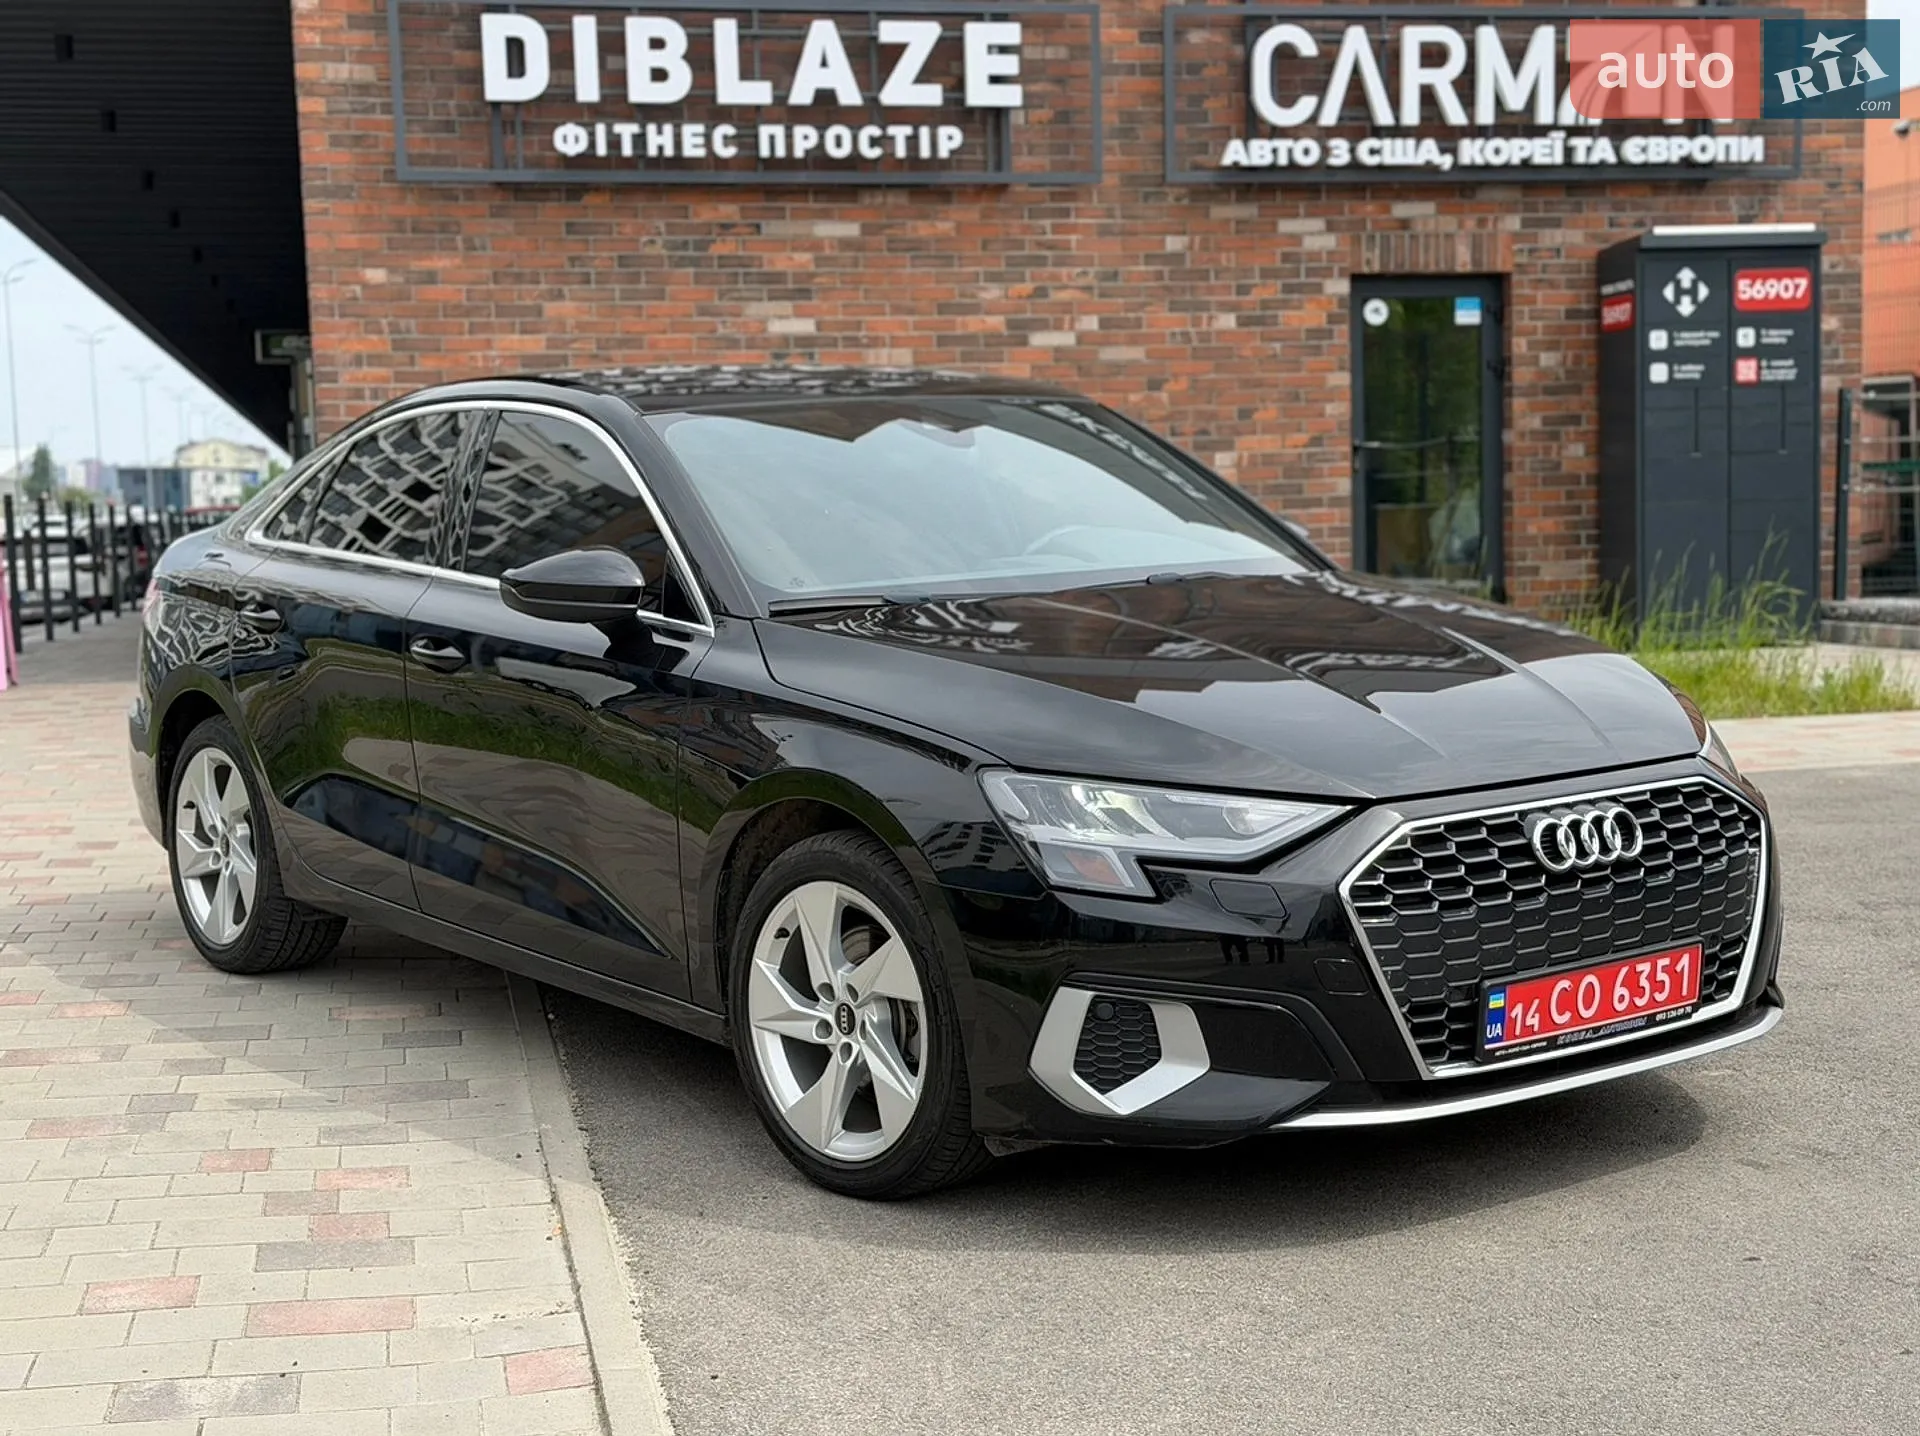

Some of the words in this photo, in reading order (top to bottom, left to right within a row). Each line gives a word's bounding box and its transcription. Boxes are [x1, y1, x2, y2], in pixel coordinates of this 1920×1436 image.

[480, 12, 1023, 107] DIBLAZE
[553, 121, 739, 159] ФІТНЕС
[758, 123, 964, 160] ПРОСТІР
[1220, 137, 1321, 167] АВТО
[1356, 137, 1454, 171] США,
[1457, 130, 1567, 167] КОРЕЇ
[1567, 135, 1618, 165] ТА
[1621, 135, 1765, 165] ЄВРОПИ
[1737, 276, 1809, 300] 56907
[1510, 998, 1540, 1037] 14
[1549, 973, 1601, 1025] CO
[1612, 952, 1691, 1012] 6351
[1486, 1022, 1503, 1038] UA
